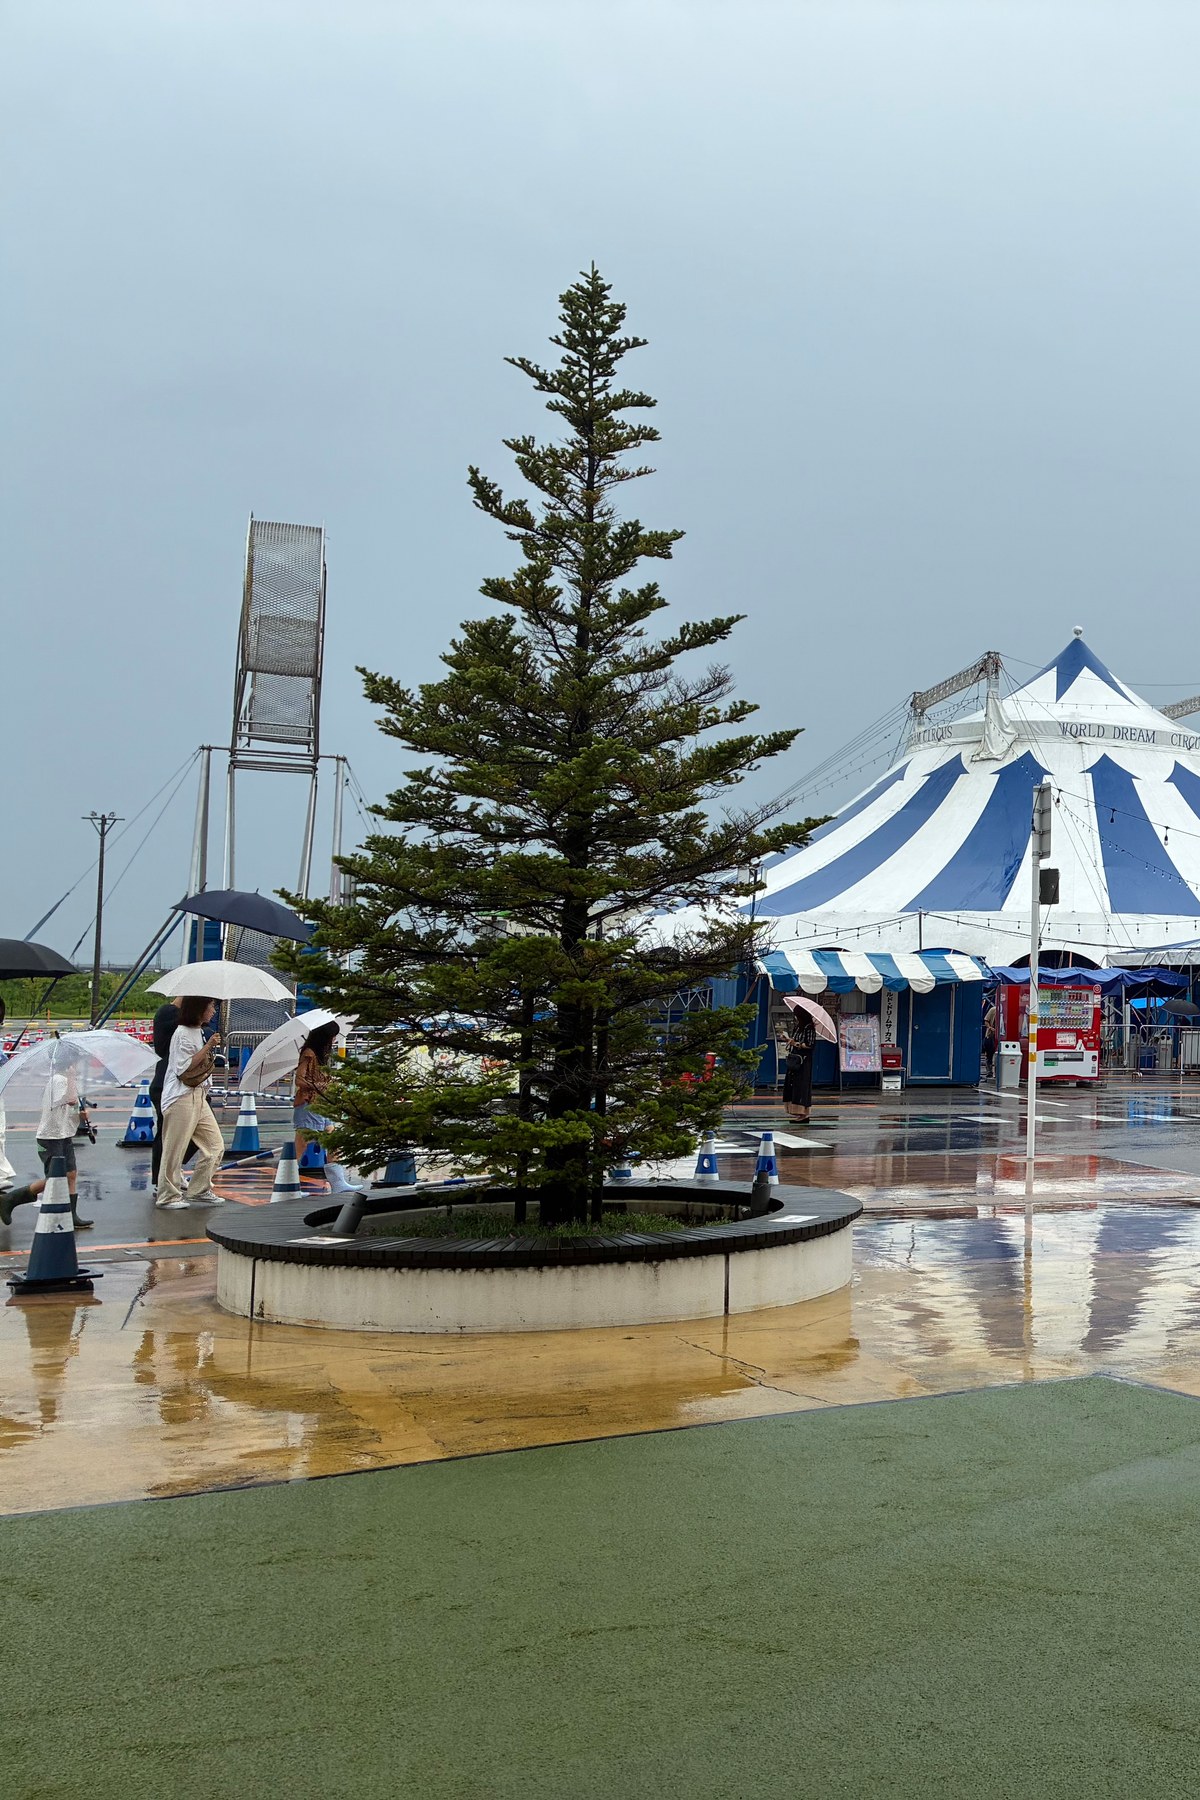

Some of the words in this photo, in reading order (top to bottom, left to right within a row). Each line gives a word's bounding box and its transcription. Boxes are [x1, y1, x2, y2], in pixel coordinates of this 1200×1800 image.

[922, 725, 953, 742] CIRCUS
[1060, 722, 1105, 738] WORLD
[1113, 726, 1156, 743] DREAM
